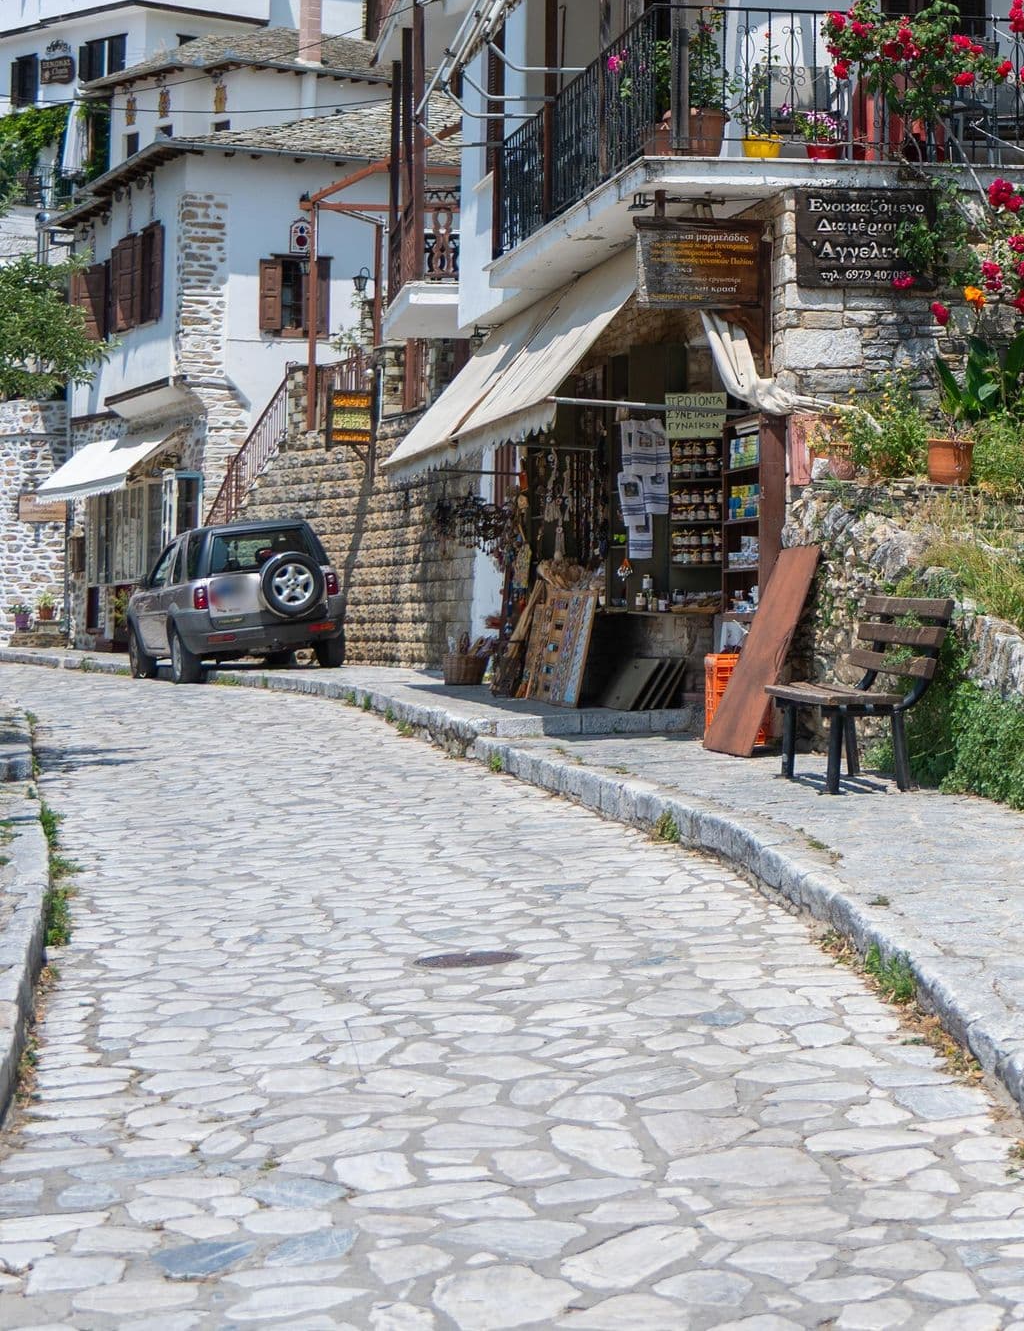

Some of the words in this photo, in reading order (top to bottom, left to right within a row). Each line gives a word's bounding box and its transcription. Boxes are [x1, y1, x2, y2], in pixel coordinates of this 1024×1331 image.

[696, 232, 749, 243] μαρμελάδες
[846, 270, 871, 279] 6979
[711, 284, 737, 293] κρασί
[668, 422, 720, 430] ΓΥΝΑΙΚΩΝ
